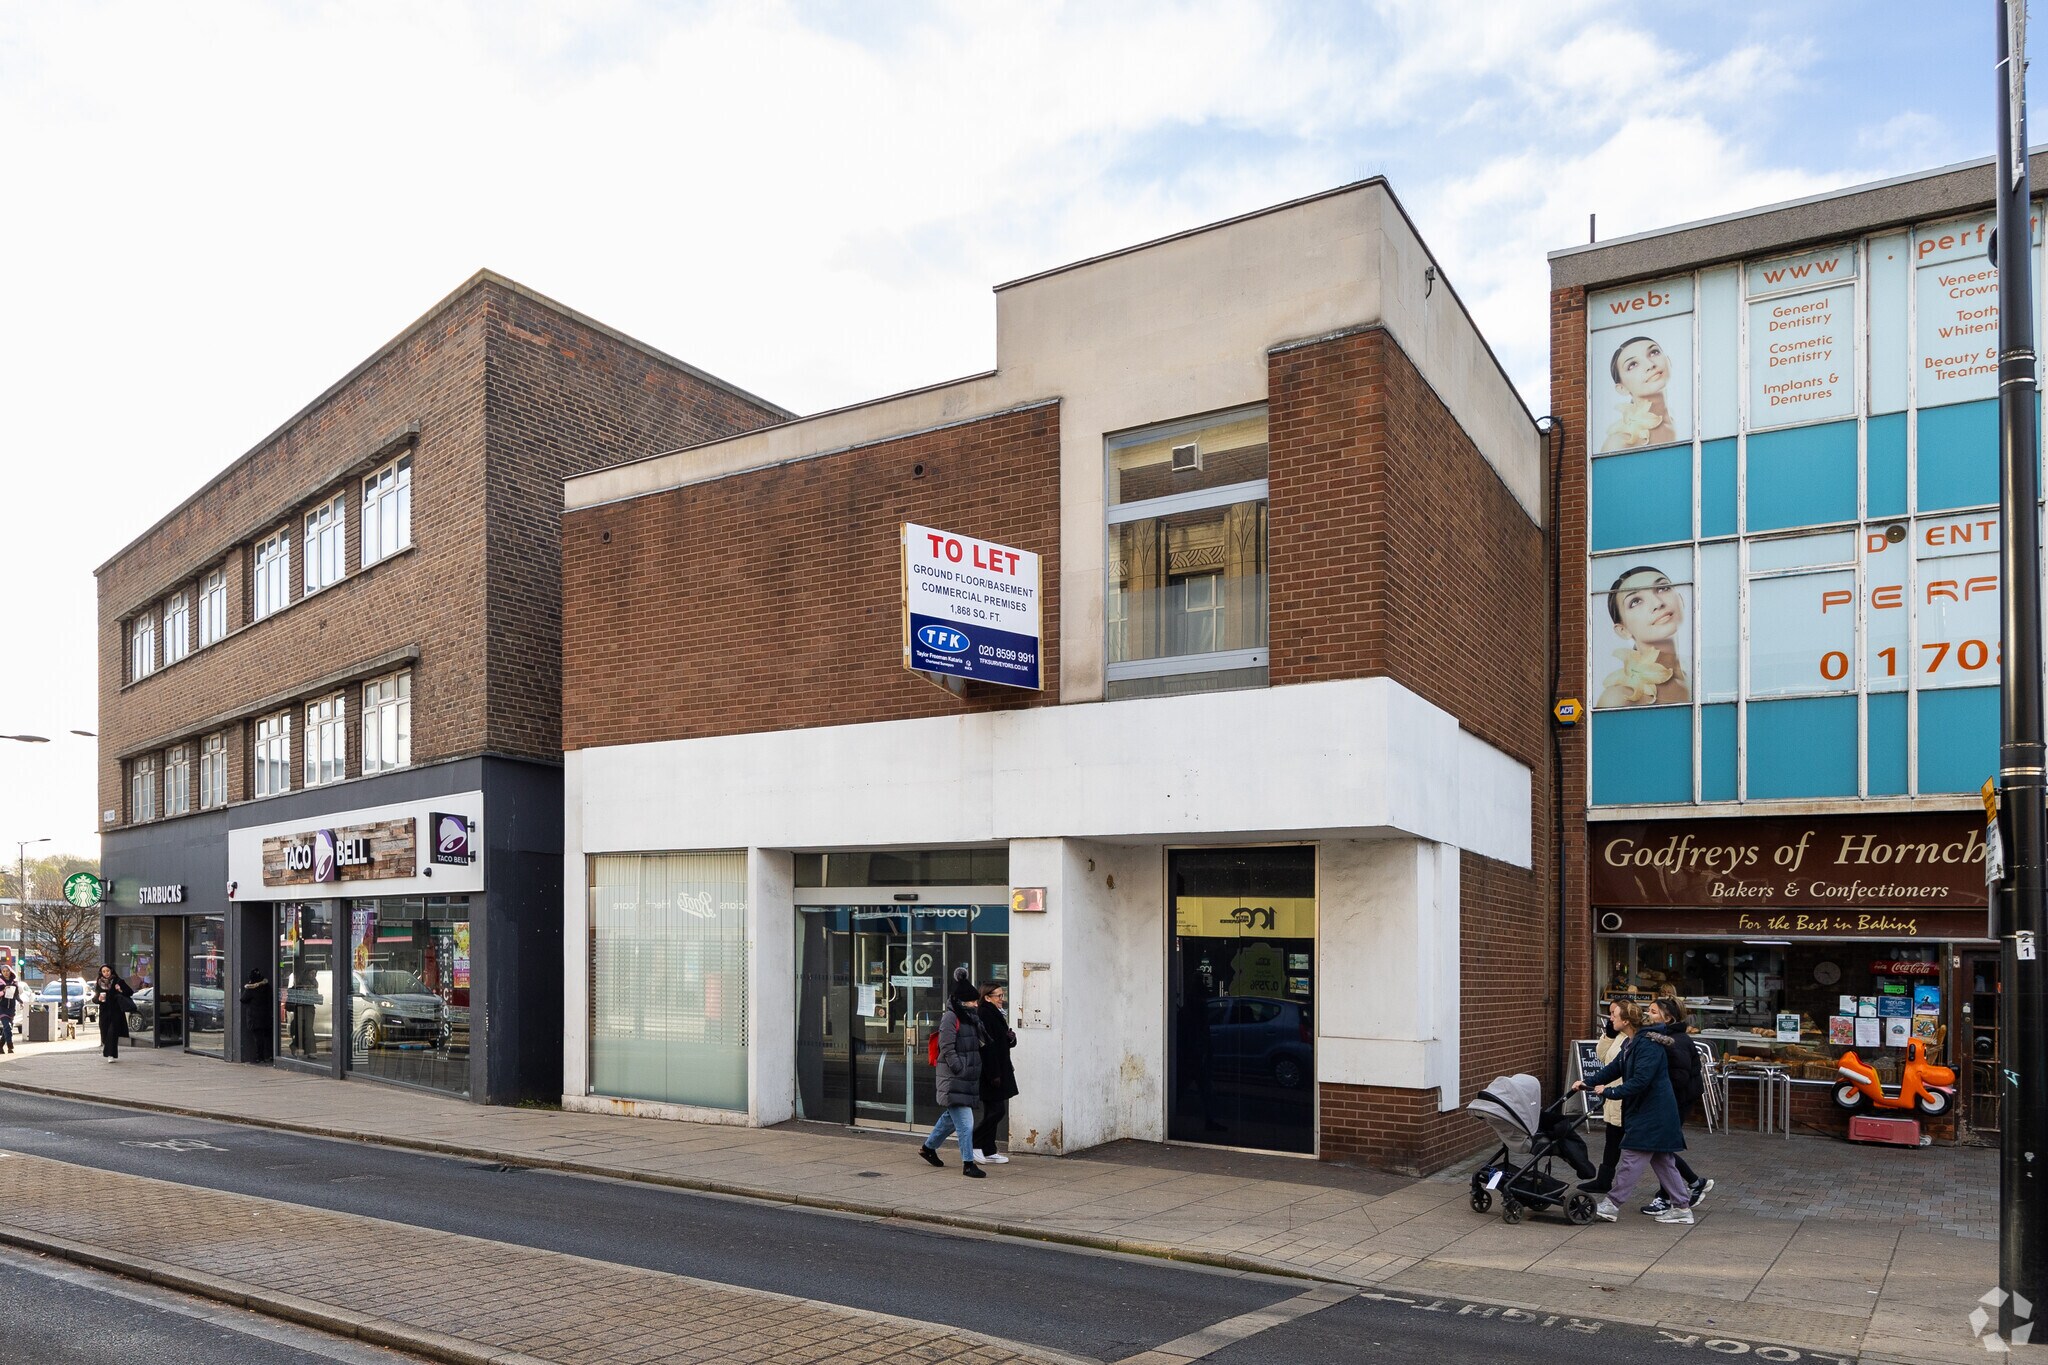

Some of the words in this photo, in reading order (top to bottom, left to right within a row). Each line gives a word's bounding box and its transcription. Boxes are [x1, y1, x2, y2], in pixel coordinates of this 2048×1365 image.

[1763, 258, 1839, 284] www
[1609, 290, 1670, 315] web:
[1773, 299, 1829, 317] General
[1956, 305, 1999, 321] Tooth
[1769, 312, 1832, 332] Dentistry
[1769, 335, 1833, 354] Cosmetic
[1769, 349, 1832, 368] Dentistry
[1925, 352, 1980, 370] Beauty
[1985, 347, 1997, 359] &
[1763, 377, 1823, 397] Implants
[1828, 372, 1839, 384] &
[1770, 389, 1833, 407] Dentures
[927, 534, 963, 563] TO
[973, 544, 1020, 576] LET
[913, 564, 953, 580] GROUND
[955, 573, 1034, 598] FLOOR/BASEMENT
[921, 581, 982, 603] COMMERCIAL
[984, 595, 1027, 612] PREMISES
[950, 604, 971, 617] 1,868
[973, 608, 988, 620] SQ.
[990, 612, 1002, 623] FT.
[926, 629, 961, 649] TFK
[978, 644, 994, 657] 020
[996, 647, 1016, 661] 8599
[1018, 651, 1035, 664] 9911
[1820, 639, 2000, 681] 0170
[1560, 705, 1574, 715] ADT
[283, 844, 311, 870] TACO
[336, 838, 368, 866] BELL
[437, 854, 453, 863] TACO
[454, 856, 468, 864] BELL
[1604, 834, 1759, 874] Godfreys
[1773, 831, 1815, 872] of
[1833, 829, 1987, 864] Hornch
[139, 884, 182, 904] STARBUCKS
[1711, 881, 1775, 897] Bakers
[1784, 881, 1800, 897] &
[1809, 879, 1949, 901] Confectioners
[1738, 914, 1762, 929] For
[1767, 915, 1790, 930] the
[1796, 914, 1828, 931] Best
[1832, 917, 1852, 930] in
[1857, 914, 1917, 935] Baking
[1410, 1300, 1604, 1335] RIGHT
